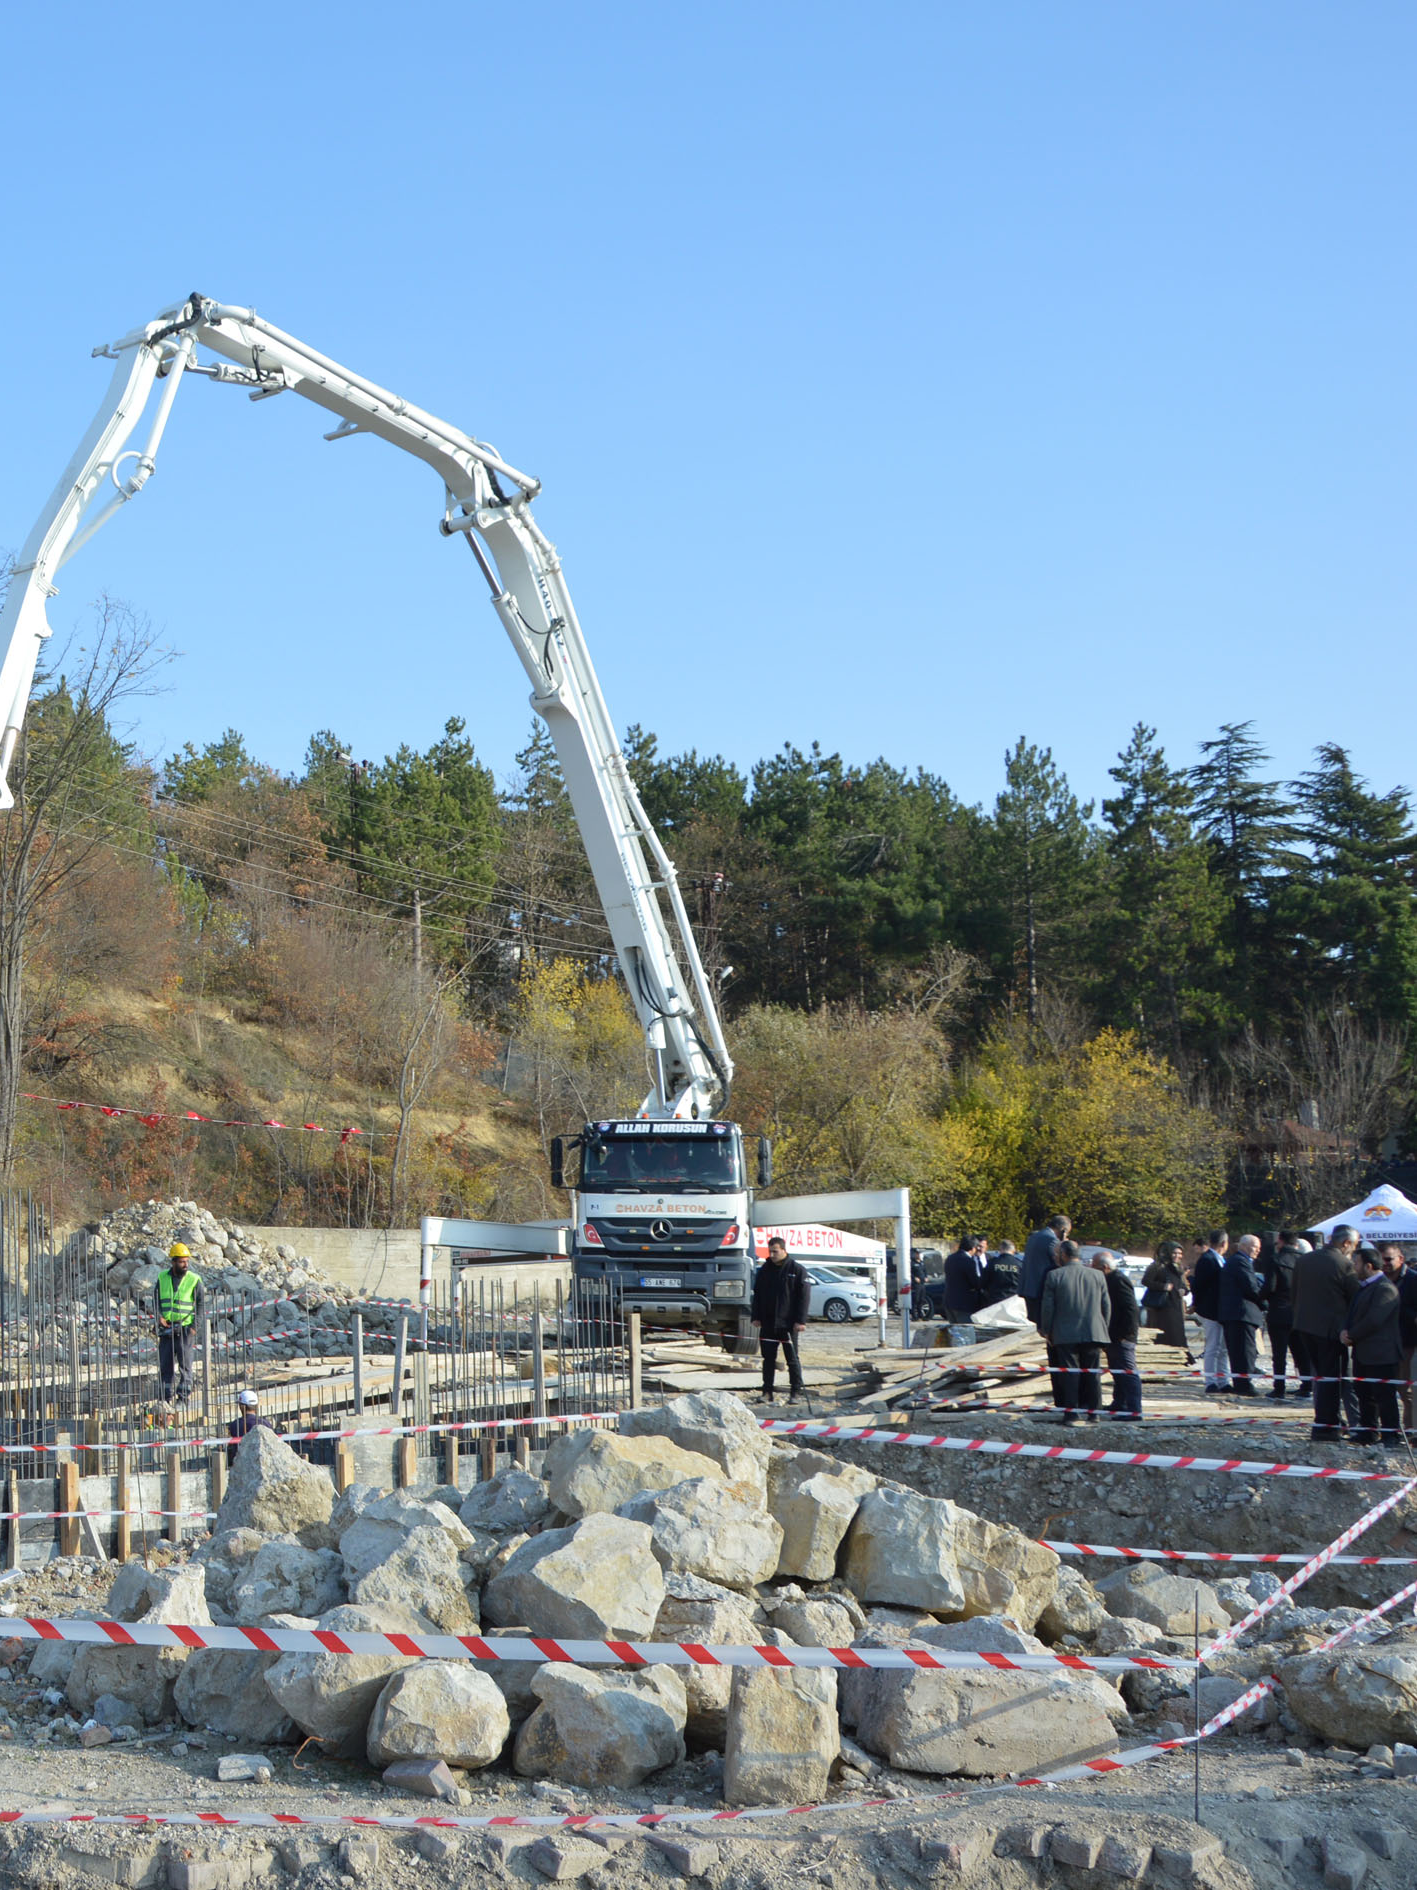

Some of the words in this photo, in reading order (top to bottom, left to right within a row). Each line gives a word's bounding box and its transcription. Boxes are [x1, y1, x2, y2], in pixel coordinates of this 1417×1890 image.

[615, 1123, 650, 1134] ALLAH
[652, 1123, 707, 1134] KORUSUN
[626, 1204, 662, 1213] HAVZA
[667, 1204, 706, 1213] BETON
[807, 1230, 843, 1249] BETON
